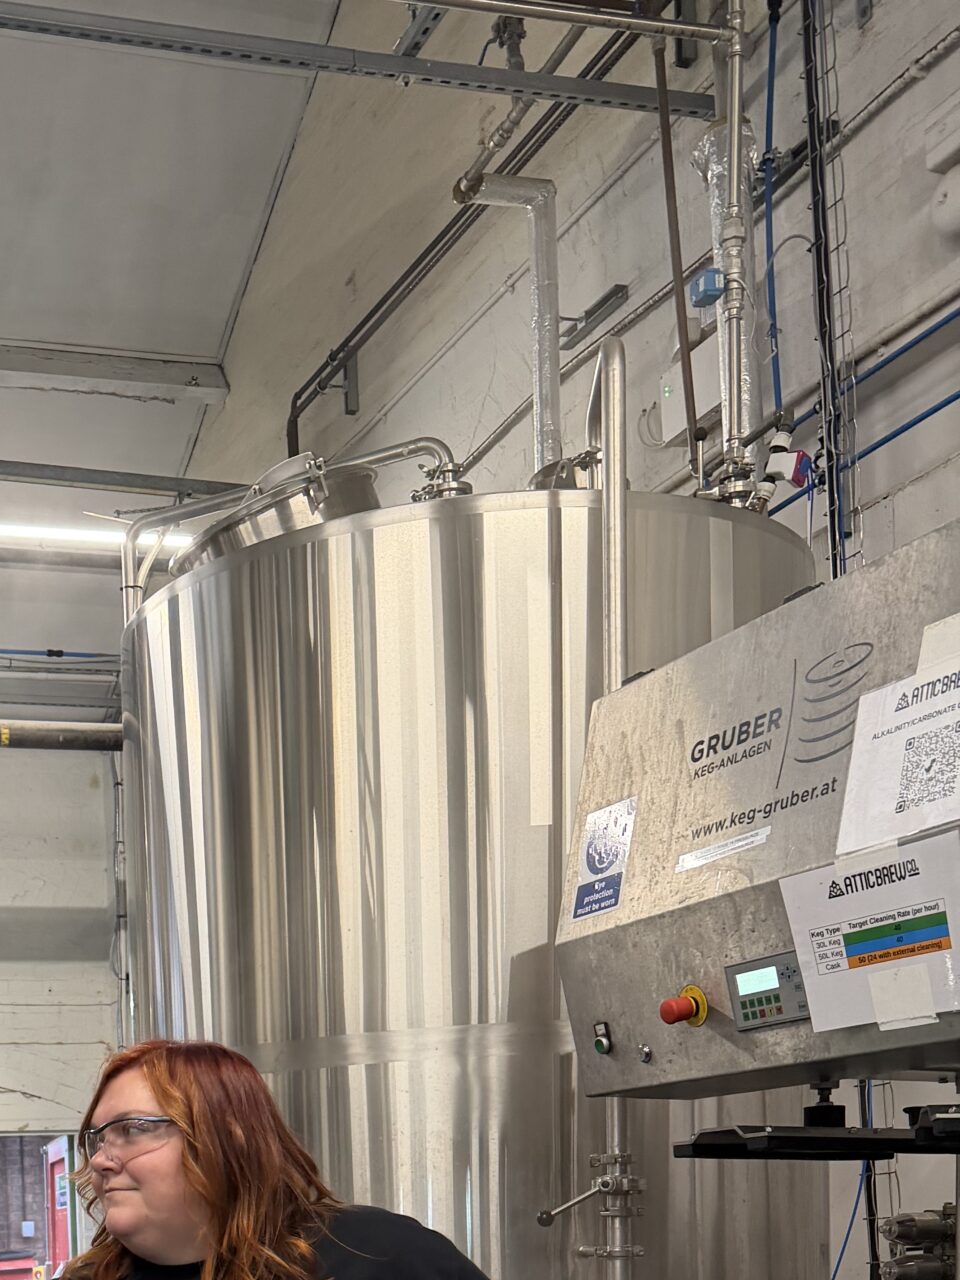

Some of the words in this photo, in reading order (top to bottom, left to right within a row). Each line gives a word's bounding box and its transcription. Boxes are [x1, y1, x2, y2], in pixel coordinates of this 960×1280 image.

[691, 707, 782, 763] GRUBER
[693, 739, 772, 780] KEG-ANLAGEN
[691, 776, 838, 841] www.keg-gruber.at
[576, 904, 591, 916] must
[591, 901, 600, 911] be
[600, 898, 615, 908] worn
[583, 888, 614, 905] protection
[811, 930, 824, 938] Keg
[825, 926, 840, 936] Type
[848, 920, 869, 930] Target
[869, 912, 897, 925] Cleaning
[897, 909, 911, 918] Rate
[911, 906, 923, 916] (per
[924, 902, 940, 912] hour)
[825, 962, 841, 971] Cask
[878, 950, 892, 960] with
[892, 945, 915, 957] external
[916, 939, 943, 952] cleaning)
[828, 938, 841, 948] Keg
[831, 949, 843, 959] Keg
